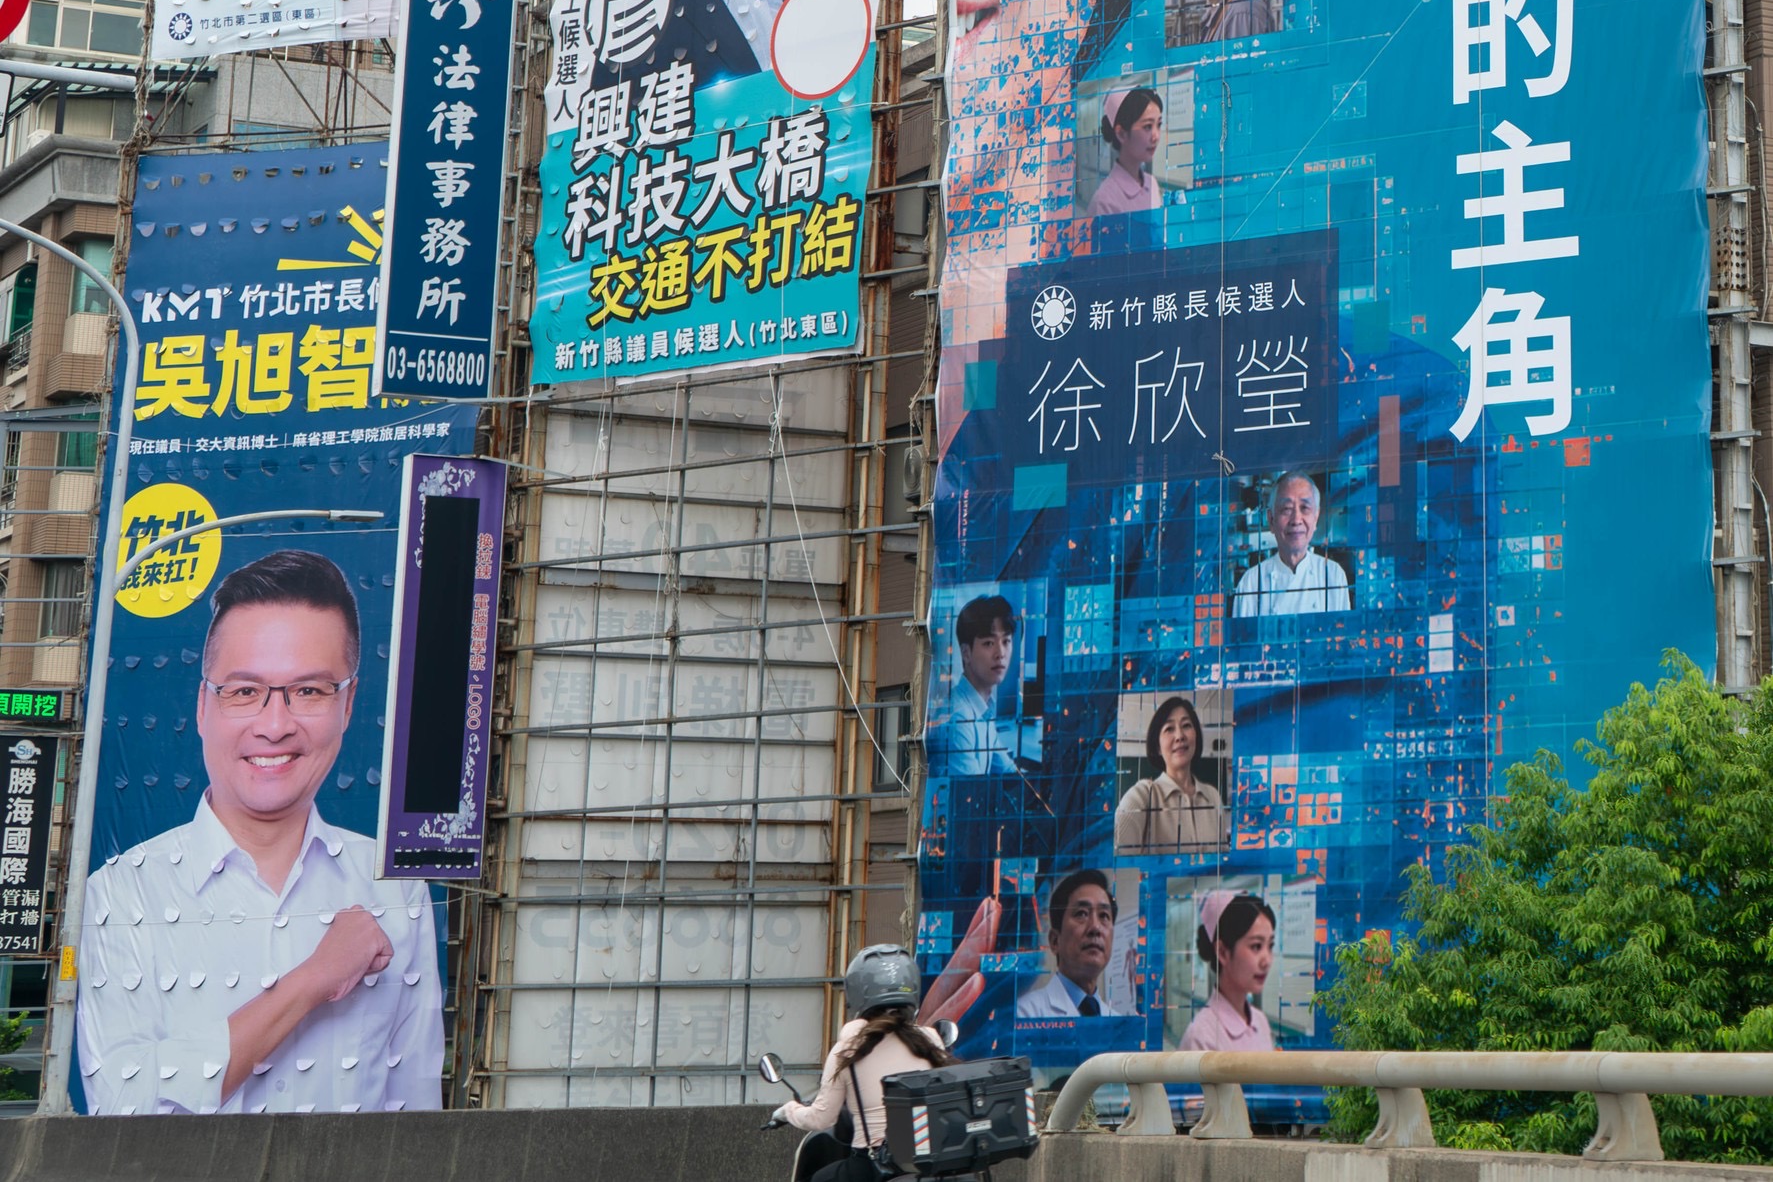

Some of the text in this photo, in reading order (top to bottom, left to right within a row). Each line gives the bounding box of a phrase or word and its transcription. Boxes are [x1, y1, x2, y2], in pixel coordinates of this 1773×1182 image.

[574, 61, 696, 171] 興建
[565, 108, 827, 259] 科技大橋
[587, 197, 863, 327] 交通不打結
[141, 283, 233, 324] KMT
[1088, 278, 1307, 332] 新竹縣長候選人
[386, 346, 485, 387] 03-6568800
[1027, 334, 1311, 455] 徐欣瑩
[129, 421, 451, 455] 現任議員 交大資訊博士 麻省理工學院旅居科學家
[124, 509, 205, 563] 竹北
[0, 767, 37, 885] 勝海國際
